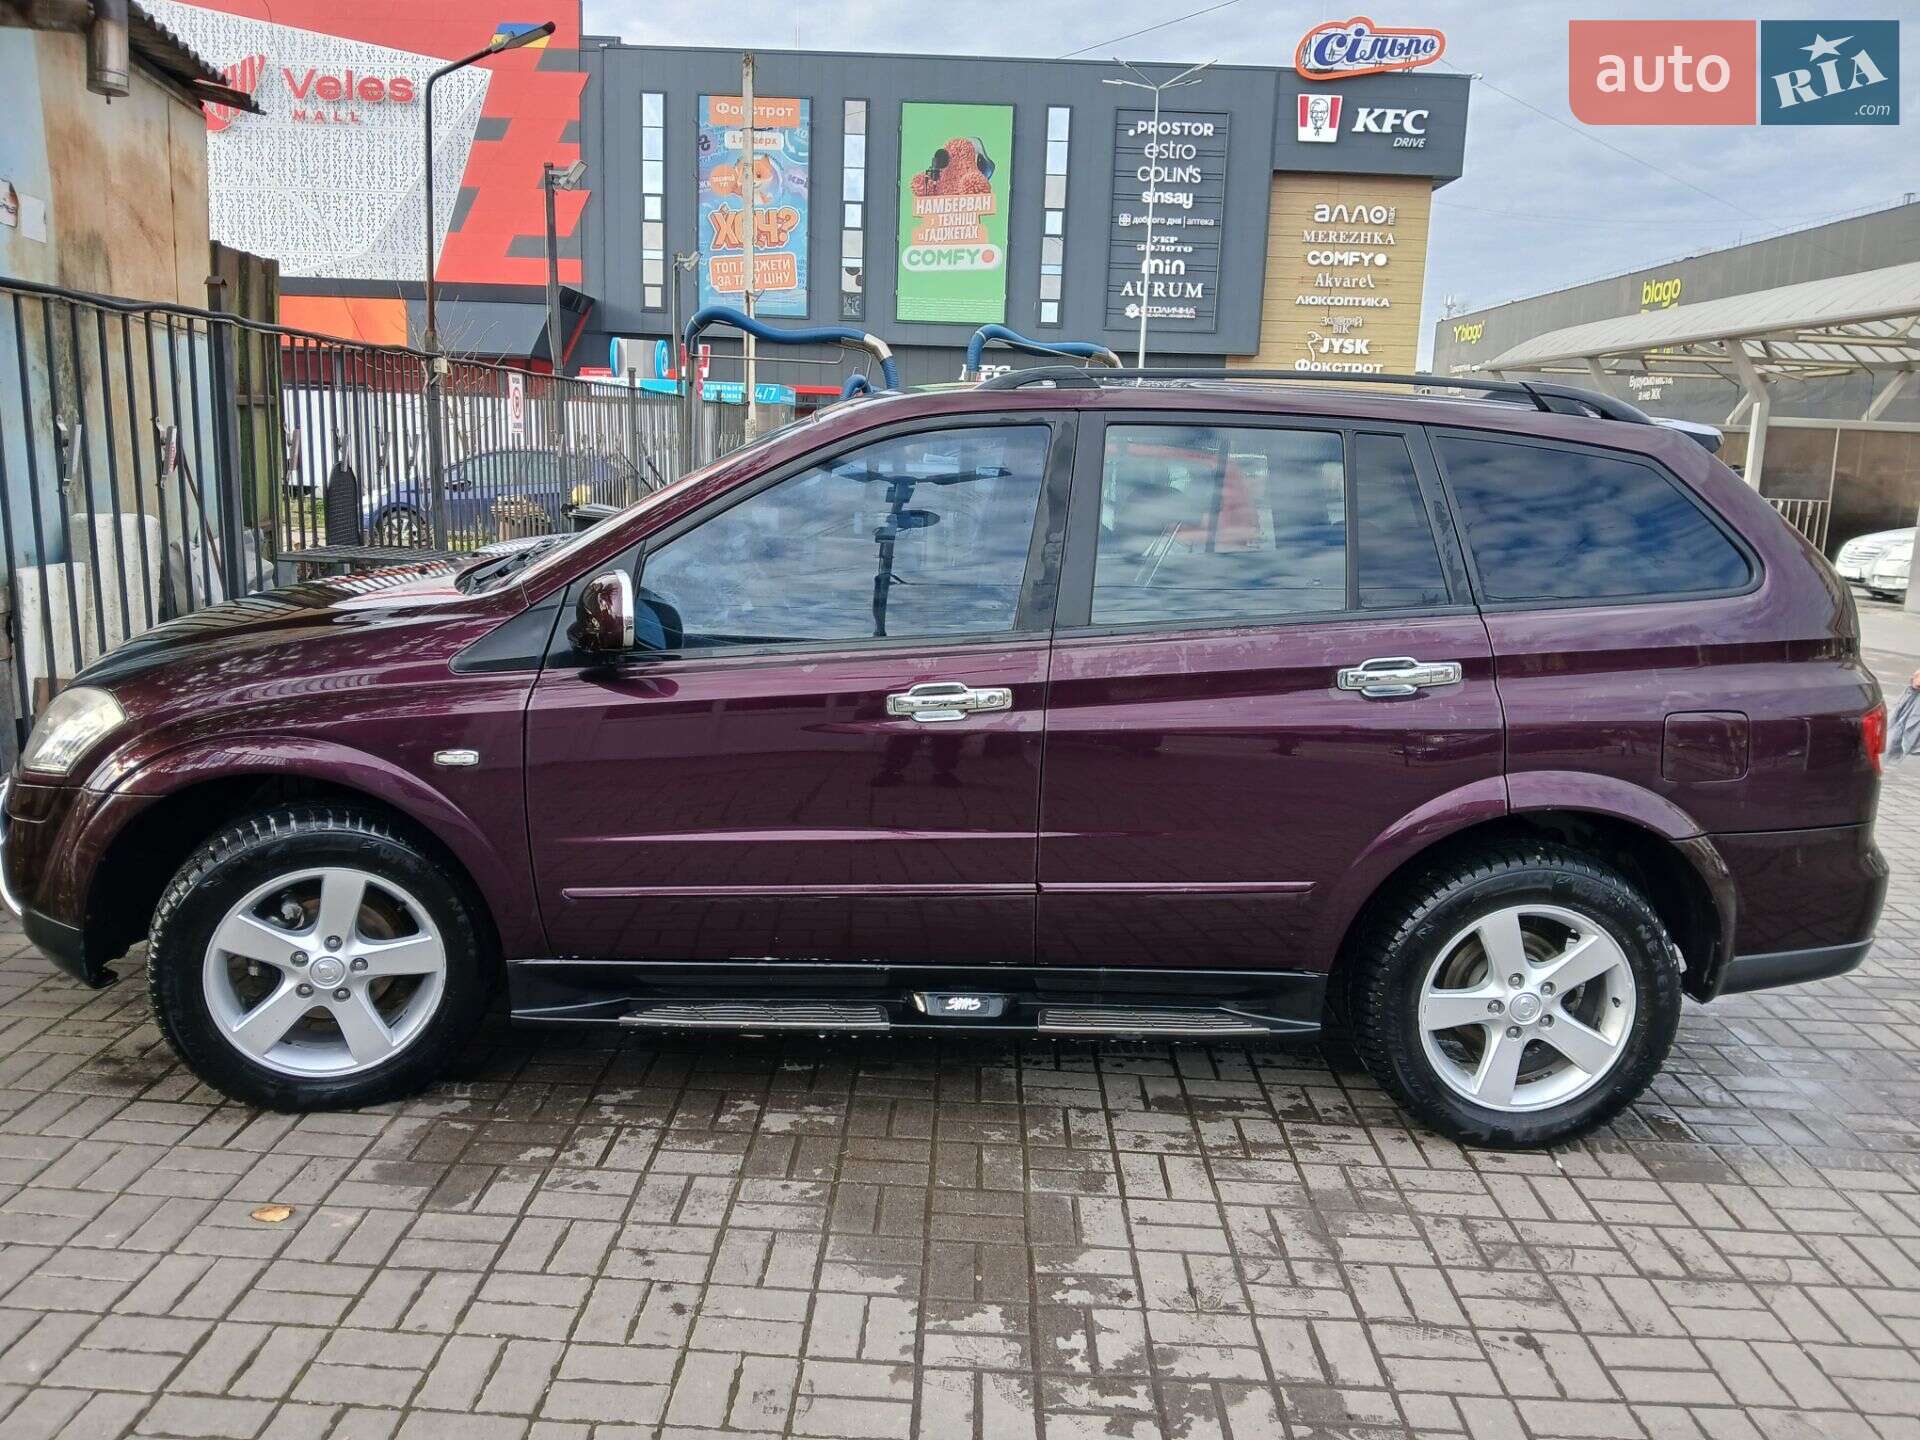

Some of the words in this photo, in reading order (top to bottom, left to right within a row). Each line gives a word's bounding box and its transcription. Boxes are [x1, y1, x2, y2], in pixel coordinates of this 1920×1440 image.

[1314, 27, 1436, 66] Сільпо
[282, 68, 414, 103] Veles
[292, 110, 362, 122] MALL
[715, 102, 794, 118] Фотрот
[1137, 120, 1214, 136] PROSTOR
[1352, 107, 1429, 135] KFC
[1144, 140, 1196, 160] estro
[1393, 137, 1426, 148] DRIVE
[1137, 165, 1201, 183] COLIN'S
[916, 196, 992, 214] НАМБЕРВАН
[1142, 190, 1193, 209] sinsay
[1303, 230, 1395, 245] MEREZHKA
[716, 261, 737, 274] ТОП
[738, 258, 791, 273] ГДЖЕТИ
[908, 249, 979, 266] COMFY
[1307, 250, 1374, 266] COMFY
[1141, 258, 1185, 275] min
[1314, 272, 1376, 288] Akvarel
[1120, 281, 1204, 298] AURUM
[1642, 278, 1681, 307] blago
[1295, 295, 1391, 307] ЛЮКСОПТИКА
[1319, 338, 1370, 355] JYSK
[755, 387, 776, 400] 4/7
